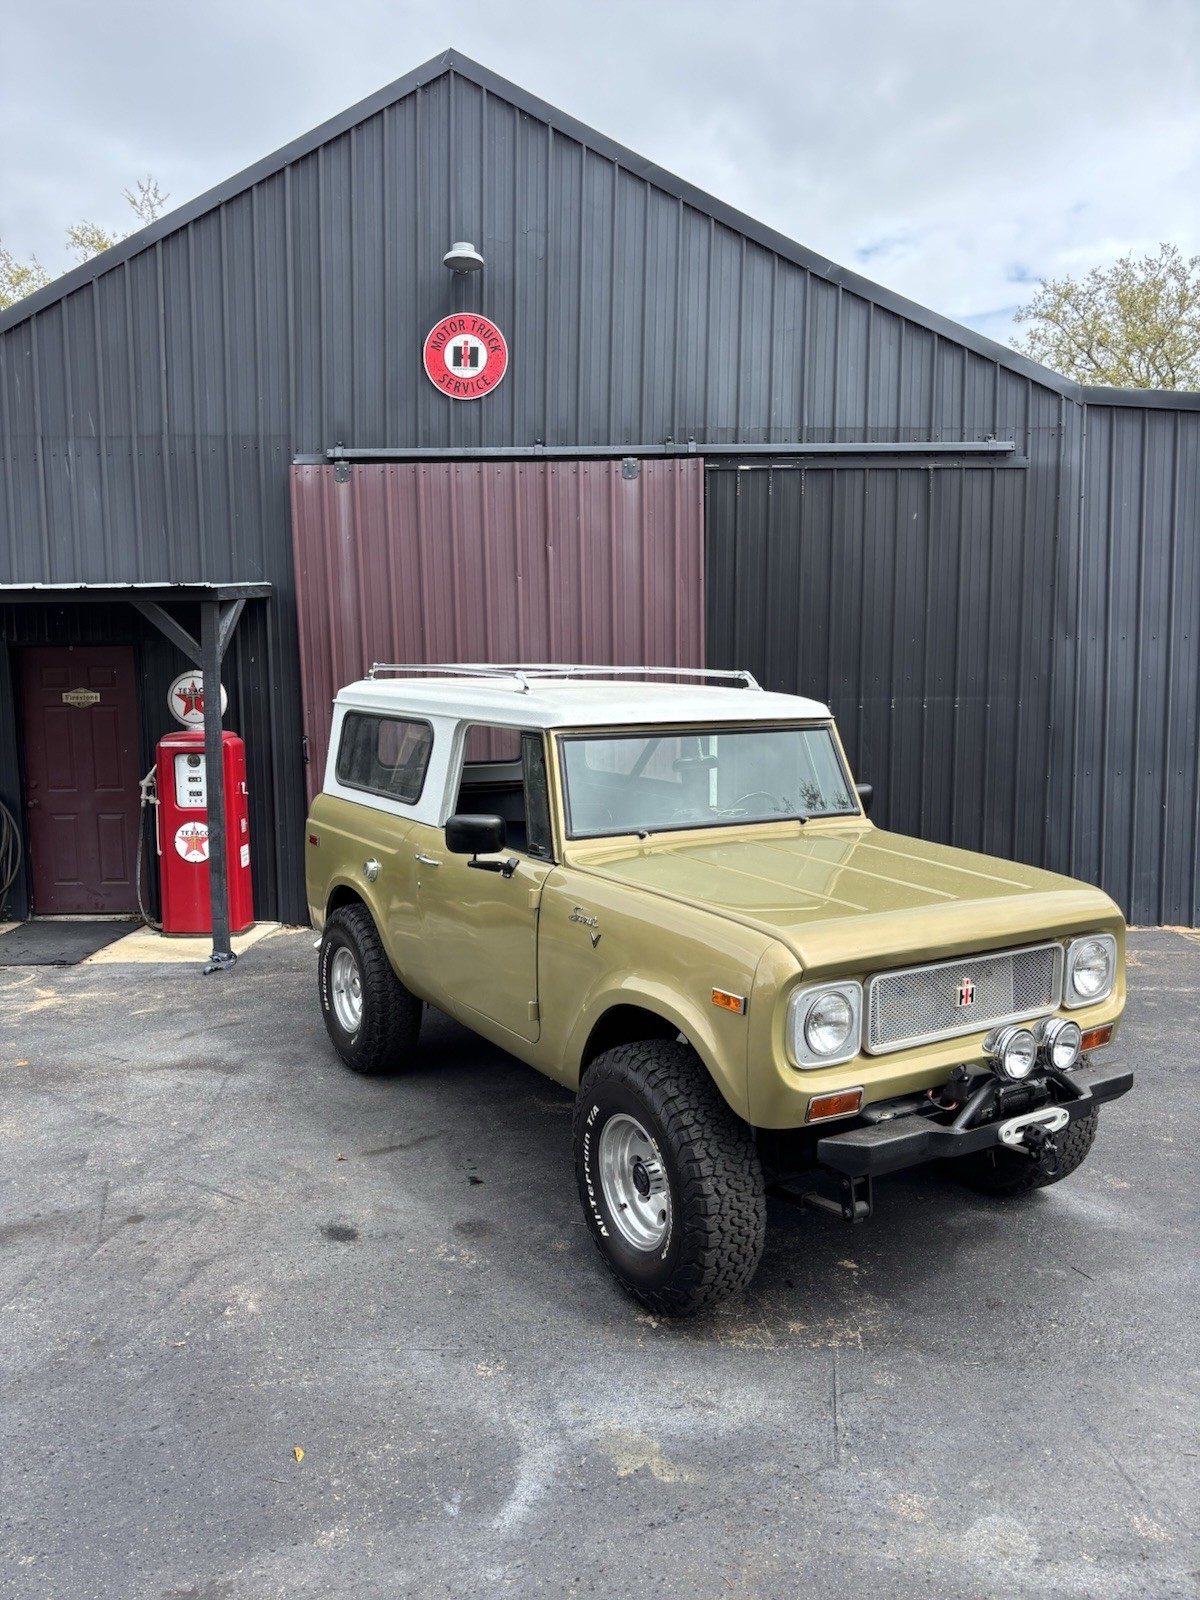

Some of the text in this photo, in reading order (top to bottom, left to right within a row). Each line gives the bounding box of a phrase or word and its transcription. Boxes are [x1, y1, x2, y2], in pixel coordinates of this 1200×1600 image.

[431, 320, 502, 353] MOTOR TRUCK
[439, 373, 491, 394] SERVICE
[586, 1104, 600, 1127] T/A
